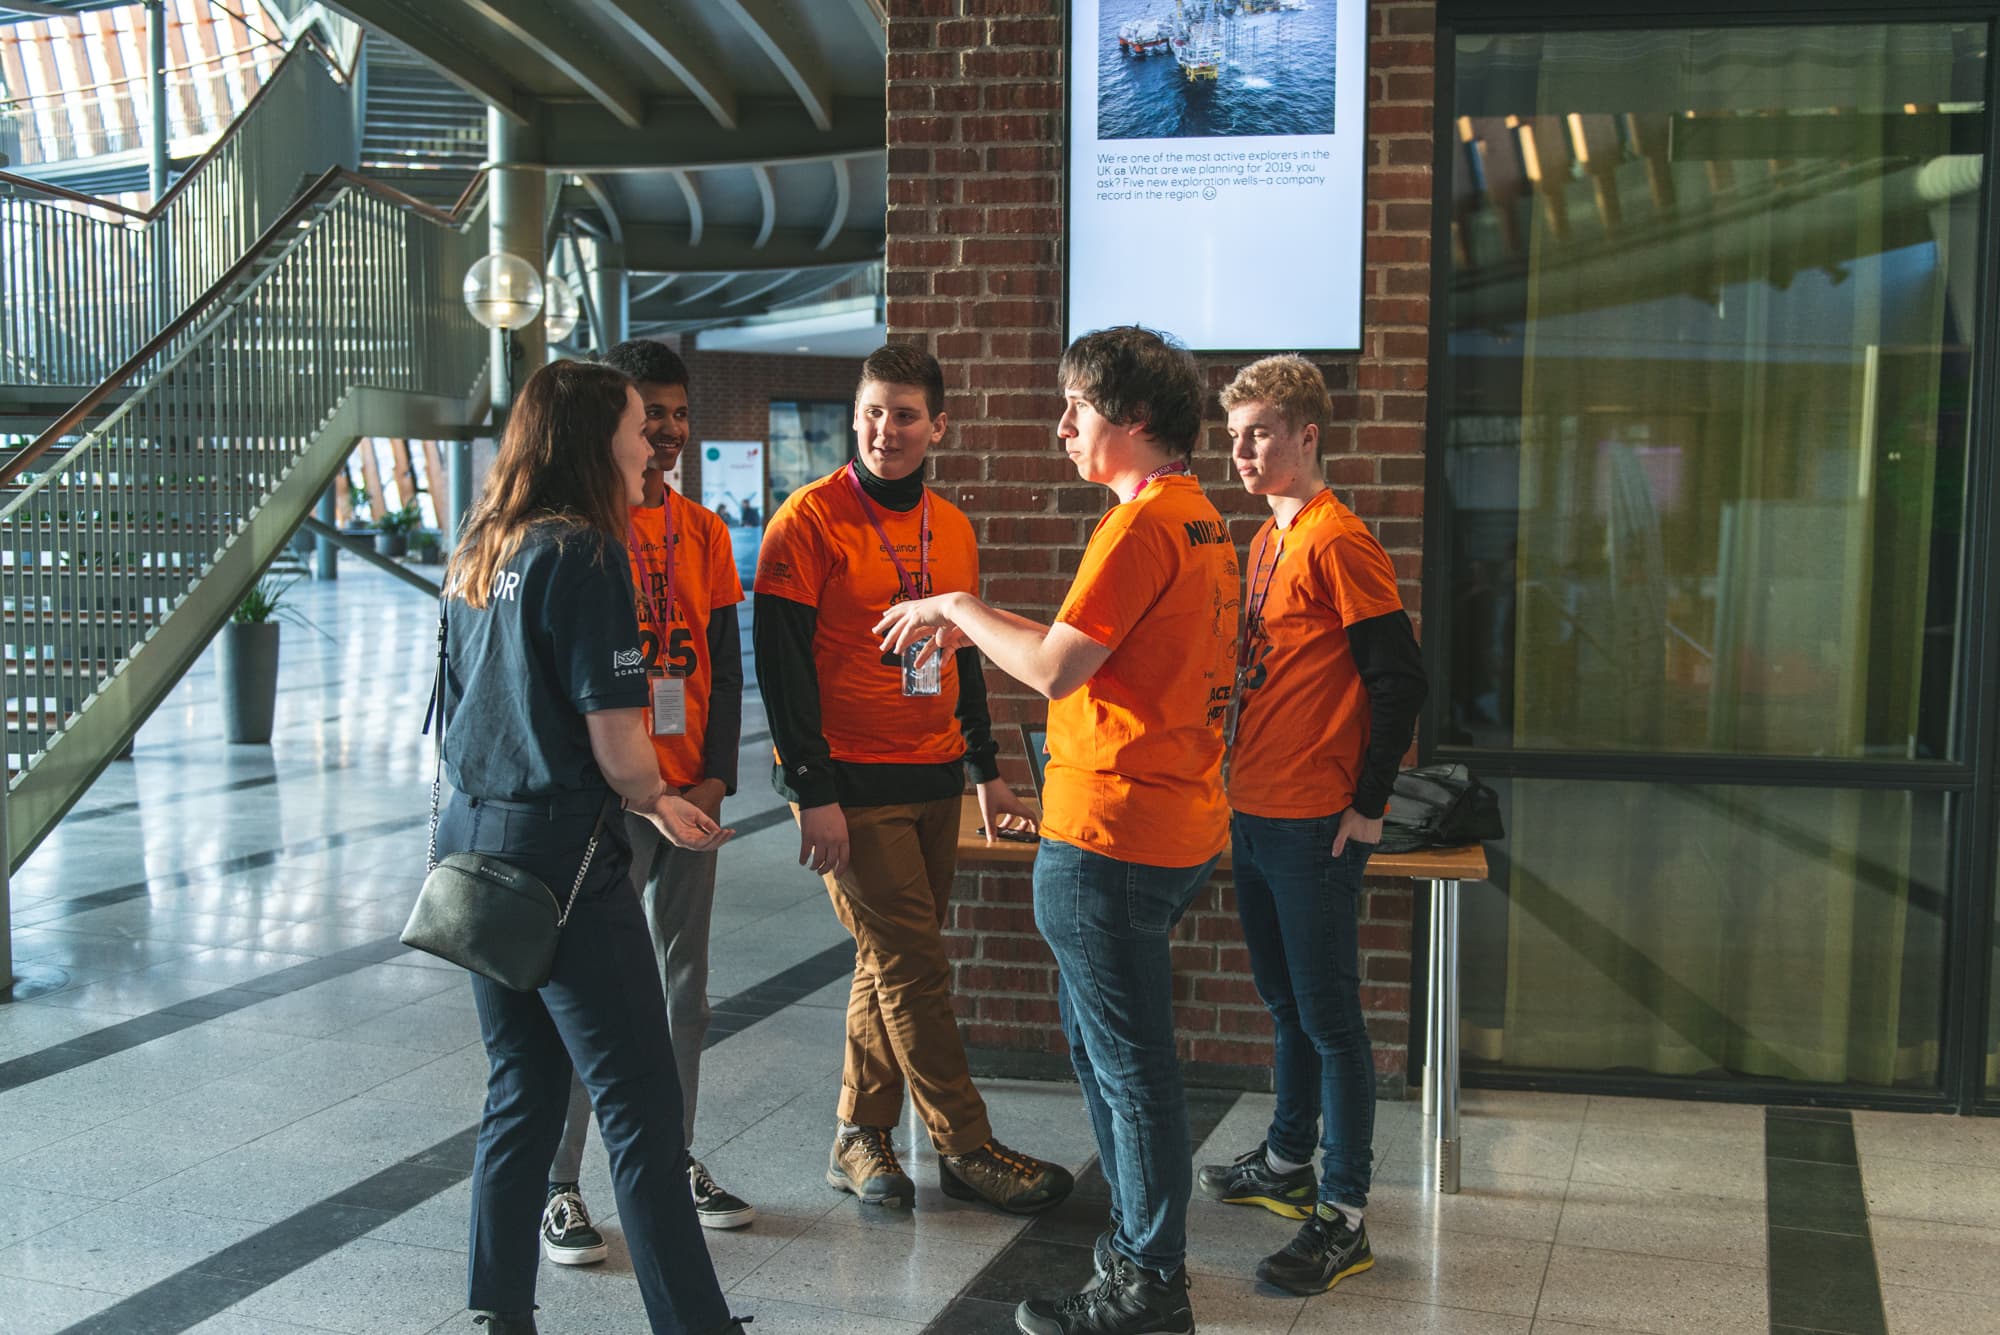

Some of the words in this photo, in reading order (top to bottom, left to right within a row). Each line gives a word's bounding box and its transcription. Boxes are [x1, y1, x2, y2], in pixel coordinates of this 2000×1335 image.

[1097, 153, 1128, 164] We're
[1130, 155, 1150, 163] one
[1152, 152, 1164, 162] of
[1165, 152, 1183, 162] the
[1186, 153, 1210, 162] most
[1213, 152, 1246, 161] active
[1248, 151, 1298, 162] explorers
[1301, 151, 1310, 159] in
[1312, 149, 1330, 160] the
[1097, 166, 1112, 176] UK
[1114, 168, 1127, 176] GB
[1129, 165, 1158, 175] What
[1160, 167, 1179, 175] are
[1181, 166, 1196, 174] we
[1199, 164, 1244, 176] planning
[1247, 163, 1261, 173] for
[1296, 163, 1316, 174] you
[1096, 177, 1121, 188] ask?
[1123, 177, 1144, 187] Five
[1147, 179, 1168, 187] new
[1170, 176, 1230, 187] exploration
[1275, 176, 1326, 186] company
[1096, 190, 1132, 200] record
[1134, 190, 1143, 199] in
[1145, 189, 1162, 199] the
[1165, 191, 1199, 201] region
[880, 544, 917, 553] euinor
